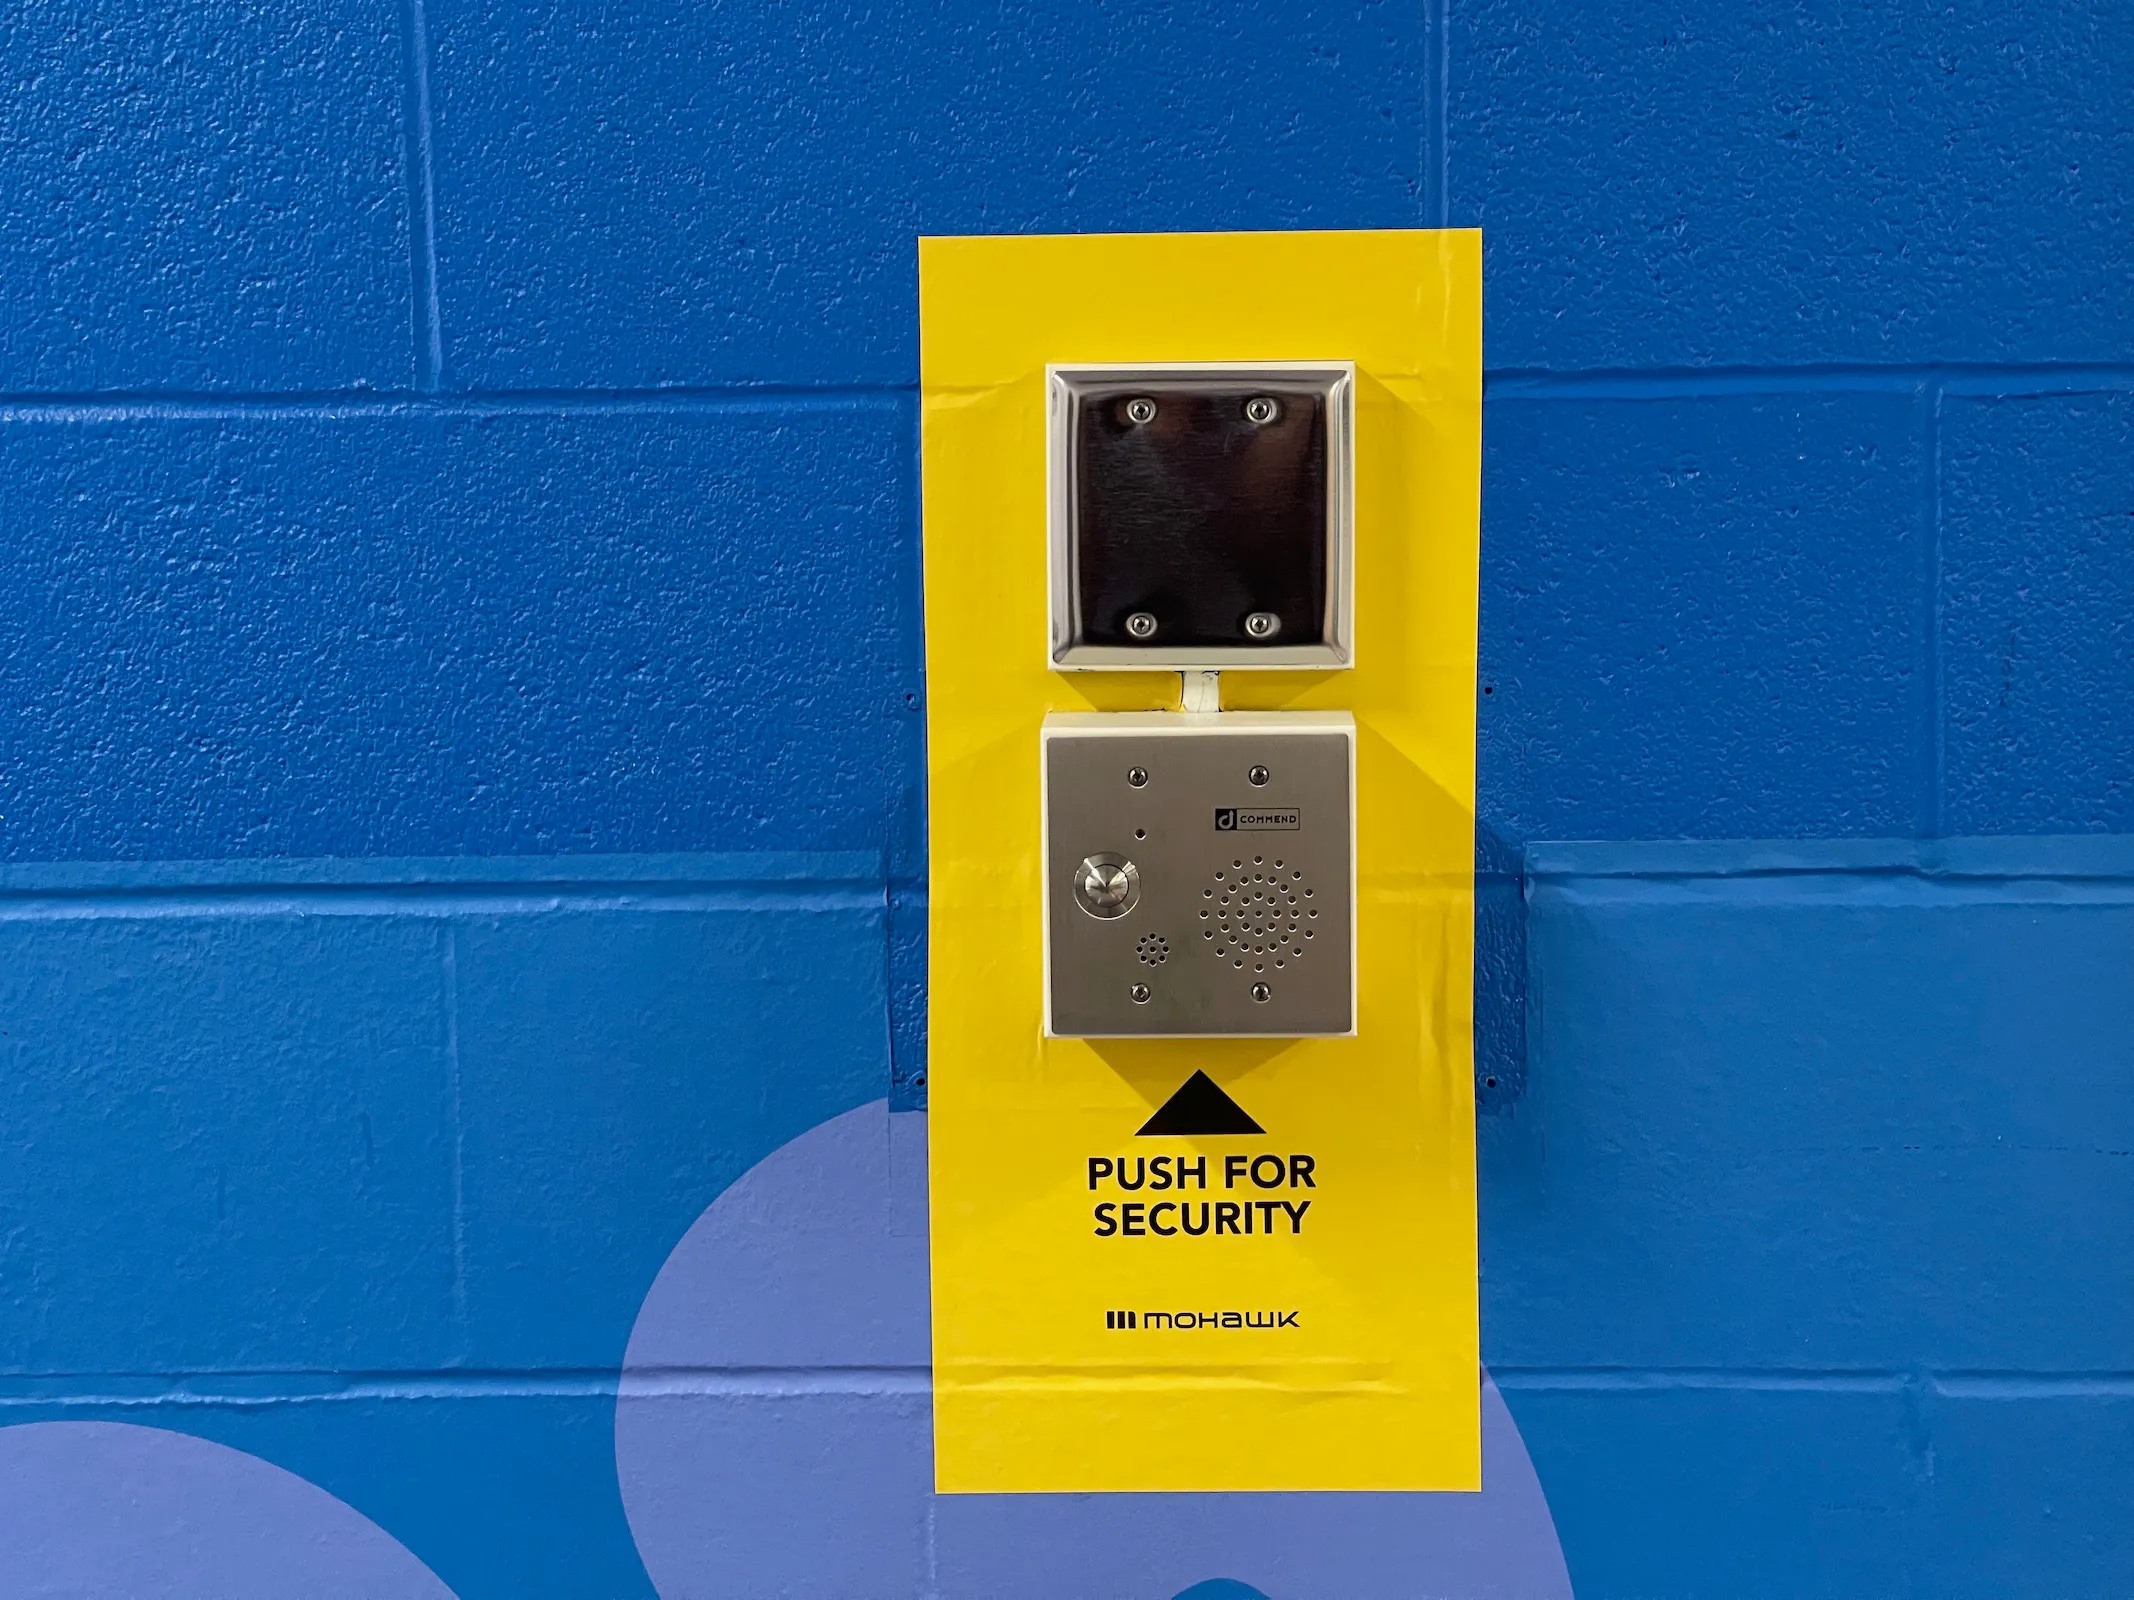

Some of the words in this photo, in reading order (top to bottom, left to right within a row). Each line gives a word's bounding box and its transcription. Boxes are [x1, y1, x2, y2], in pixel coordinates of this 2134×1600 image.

[1239, 815, 1297, 824] COMMEND
[1088, 1156, 1206, 1191] PUSH
[1225, 1154, 1317, 1189] FOR
[1094, 1200, 1312, 1237] SECURITY
